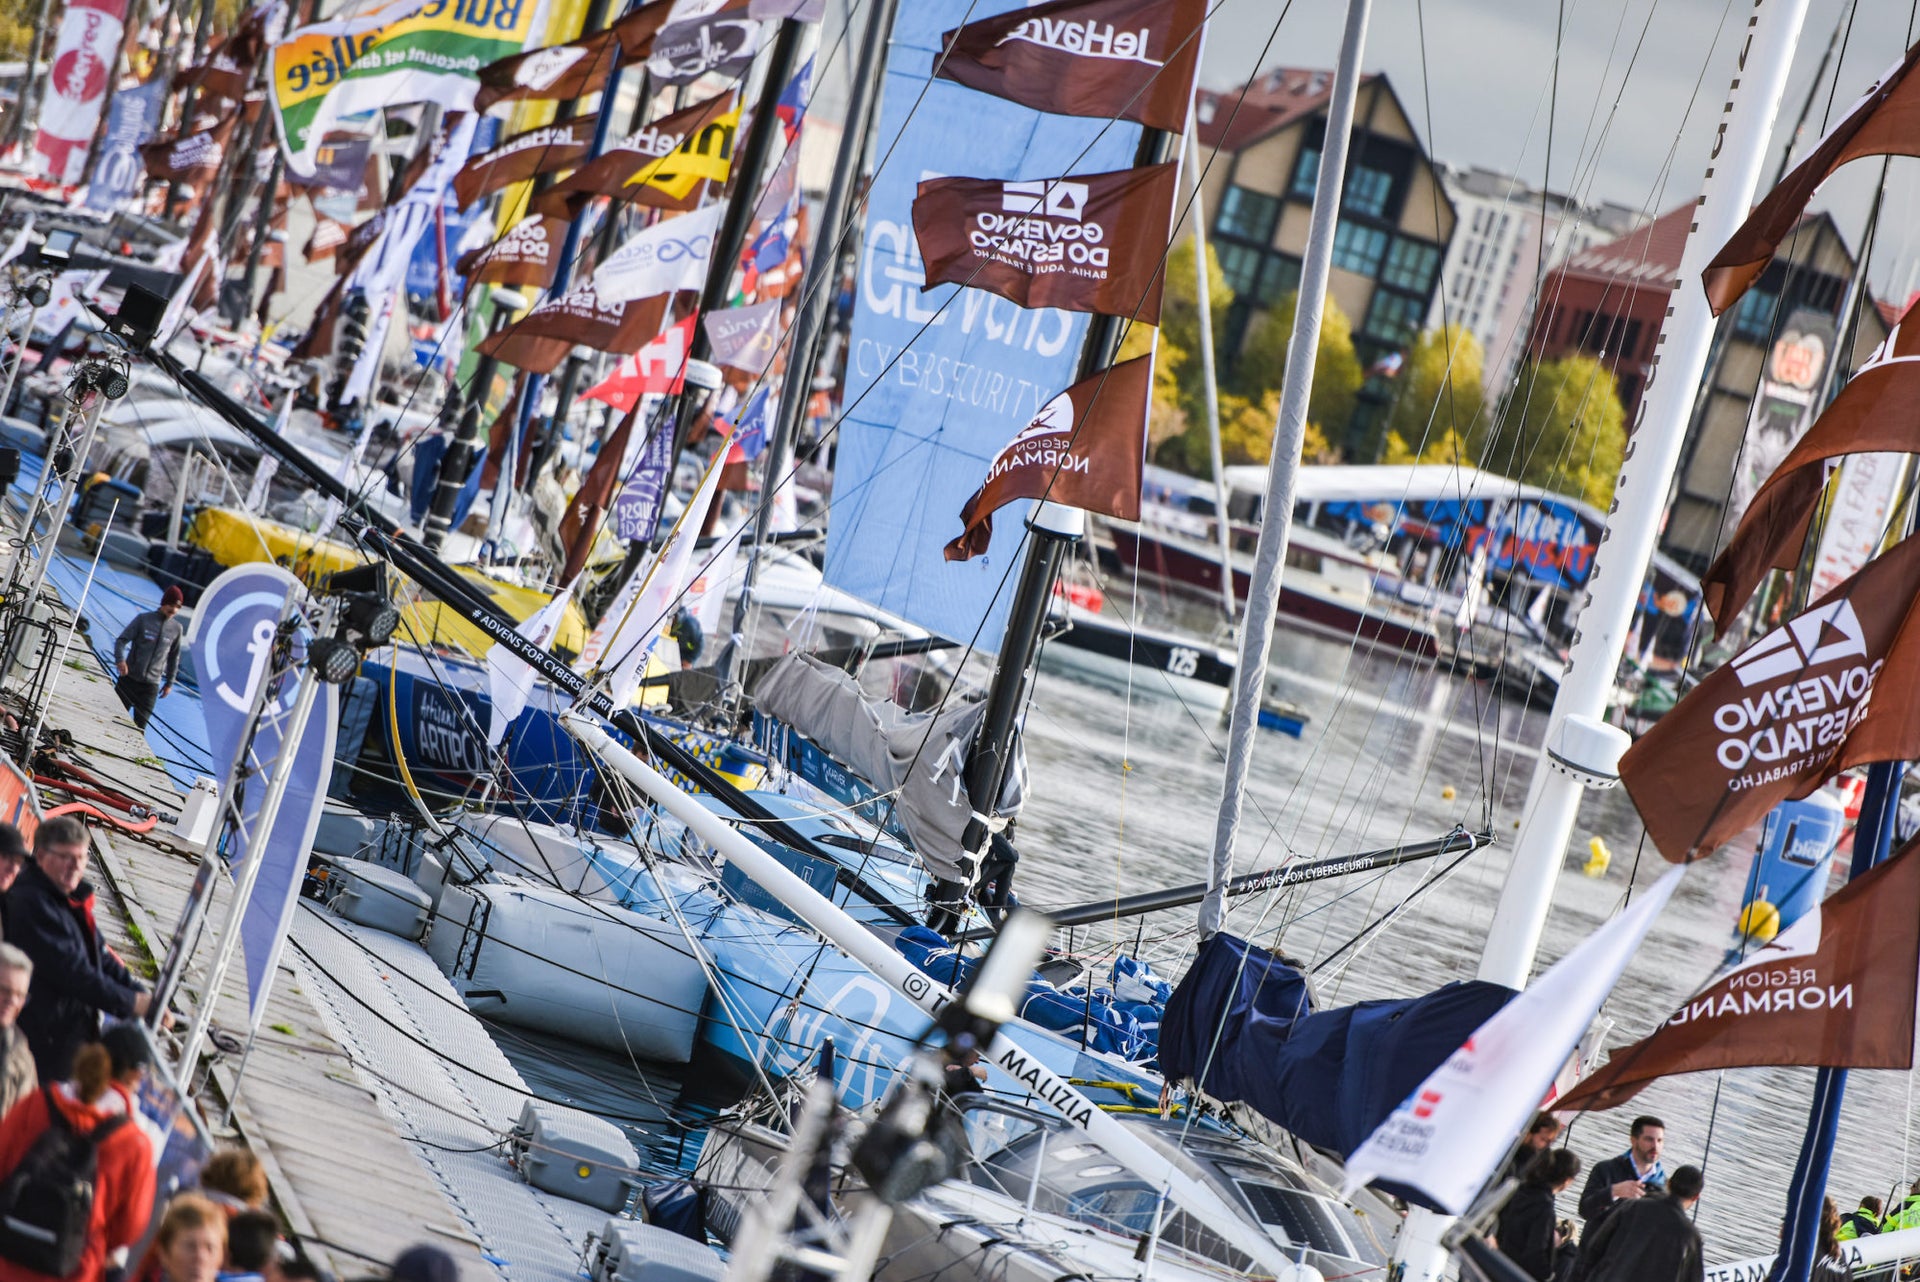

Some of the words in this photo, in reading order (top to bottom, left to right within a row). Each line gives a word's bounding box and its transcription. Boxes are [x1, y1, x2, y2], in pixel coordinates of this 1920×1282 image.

[481, 614, 523, 648] ADVENS
[521, 643, 544, 665] FOR
[1167, 646, 1201, 677] 125
[1246, 874, 1284, 891] ADVENS
[1304, 857, 1376, 879] CYBERSECURITY
[1000, 1047, 1093, 1131] MALIZIA
